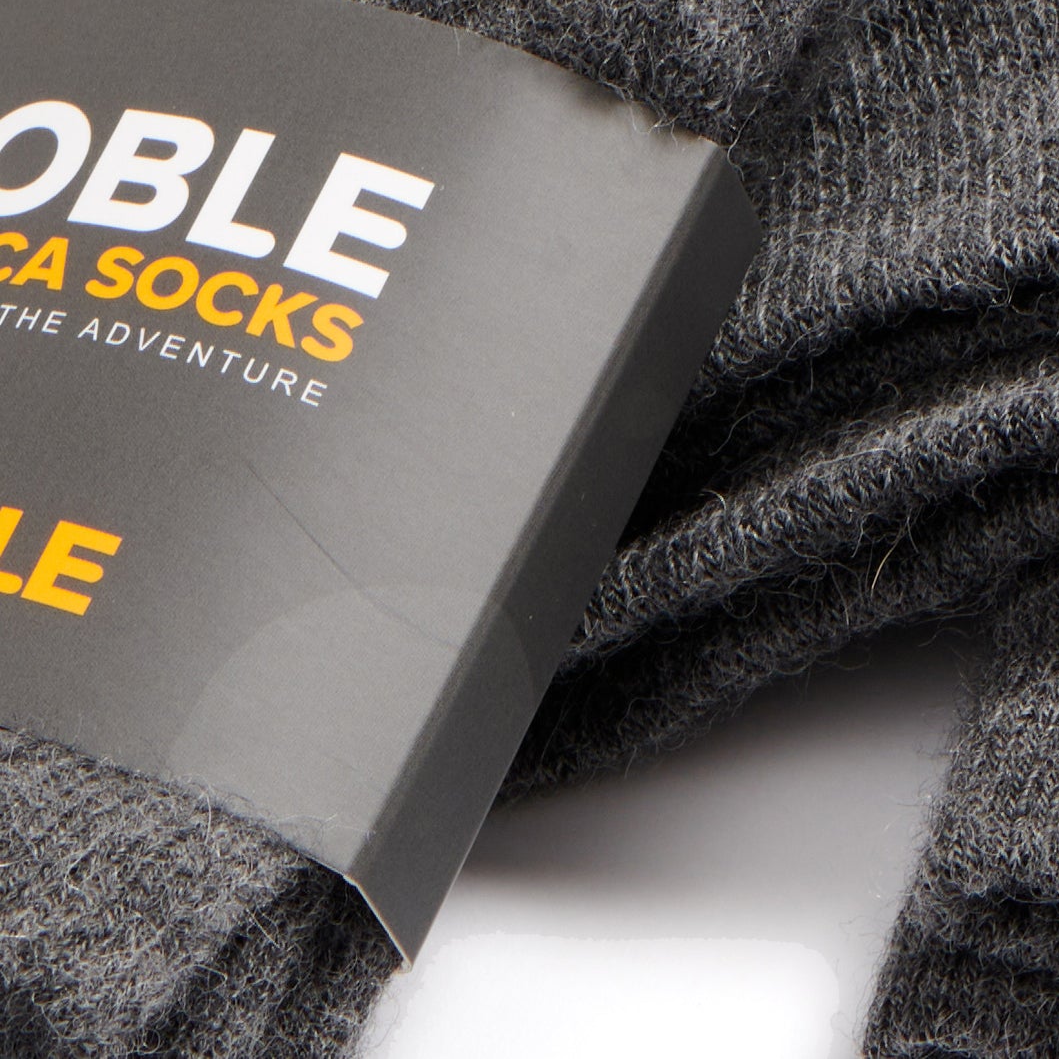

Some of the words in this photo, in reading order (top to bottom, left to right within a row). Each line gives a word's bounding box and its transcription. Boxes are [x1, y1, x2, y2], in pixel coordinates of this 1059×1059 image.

[0, 304, 68, 334] THE
[77, 318, 328, 407] ADVENTURE
[85, 245, 363, 363] SOCKS
